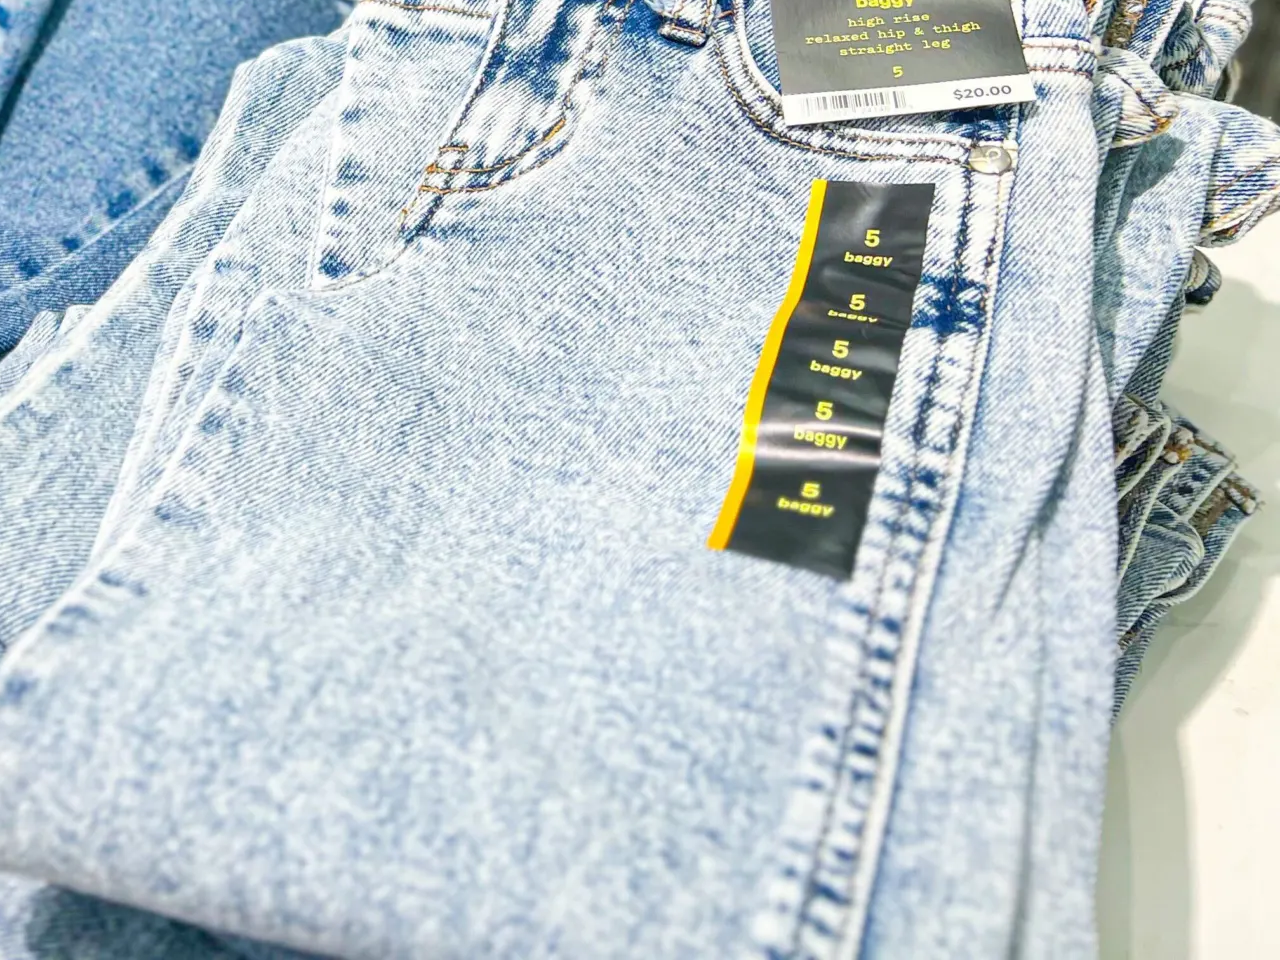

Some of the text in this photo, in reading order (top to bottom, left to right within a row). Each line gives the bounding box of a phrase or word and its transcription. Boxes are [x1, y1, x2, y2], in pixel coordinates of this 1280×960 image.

[847, 14, 930, 28] high rise
[805, 21, 981, 45] relaxed hip & thigh
[839, 40, 951, 57] straight leg
[892, 66, 904, 78] 5
[952, 84, 1013, 101] $20.00
[864, 229, 880, 247] 5
[844, 251, 893, 268] baggy
[849, 294, 866, 310] 5
[827, 309, 879, 323] baggy
[832, 340, 850, 358] 5
[810, 360, 862, 380] baggy
[814, 401, 833, 420] 5
[794, 424, 847, 450] baggy
[800, 483, 821, 499] 5
[777, 498, 834, 516] baggy
